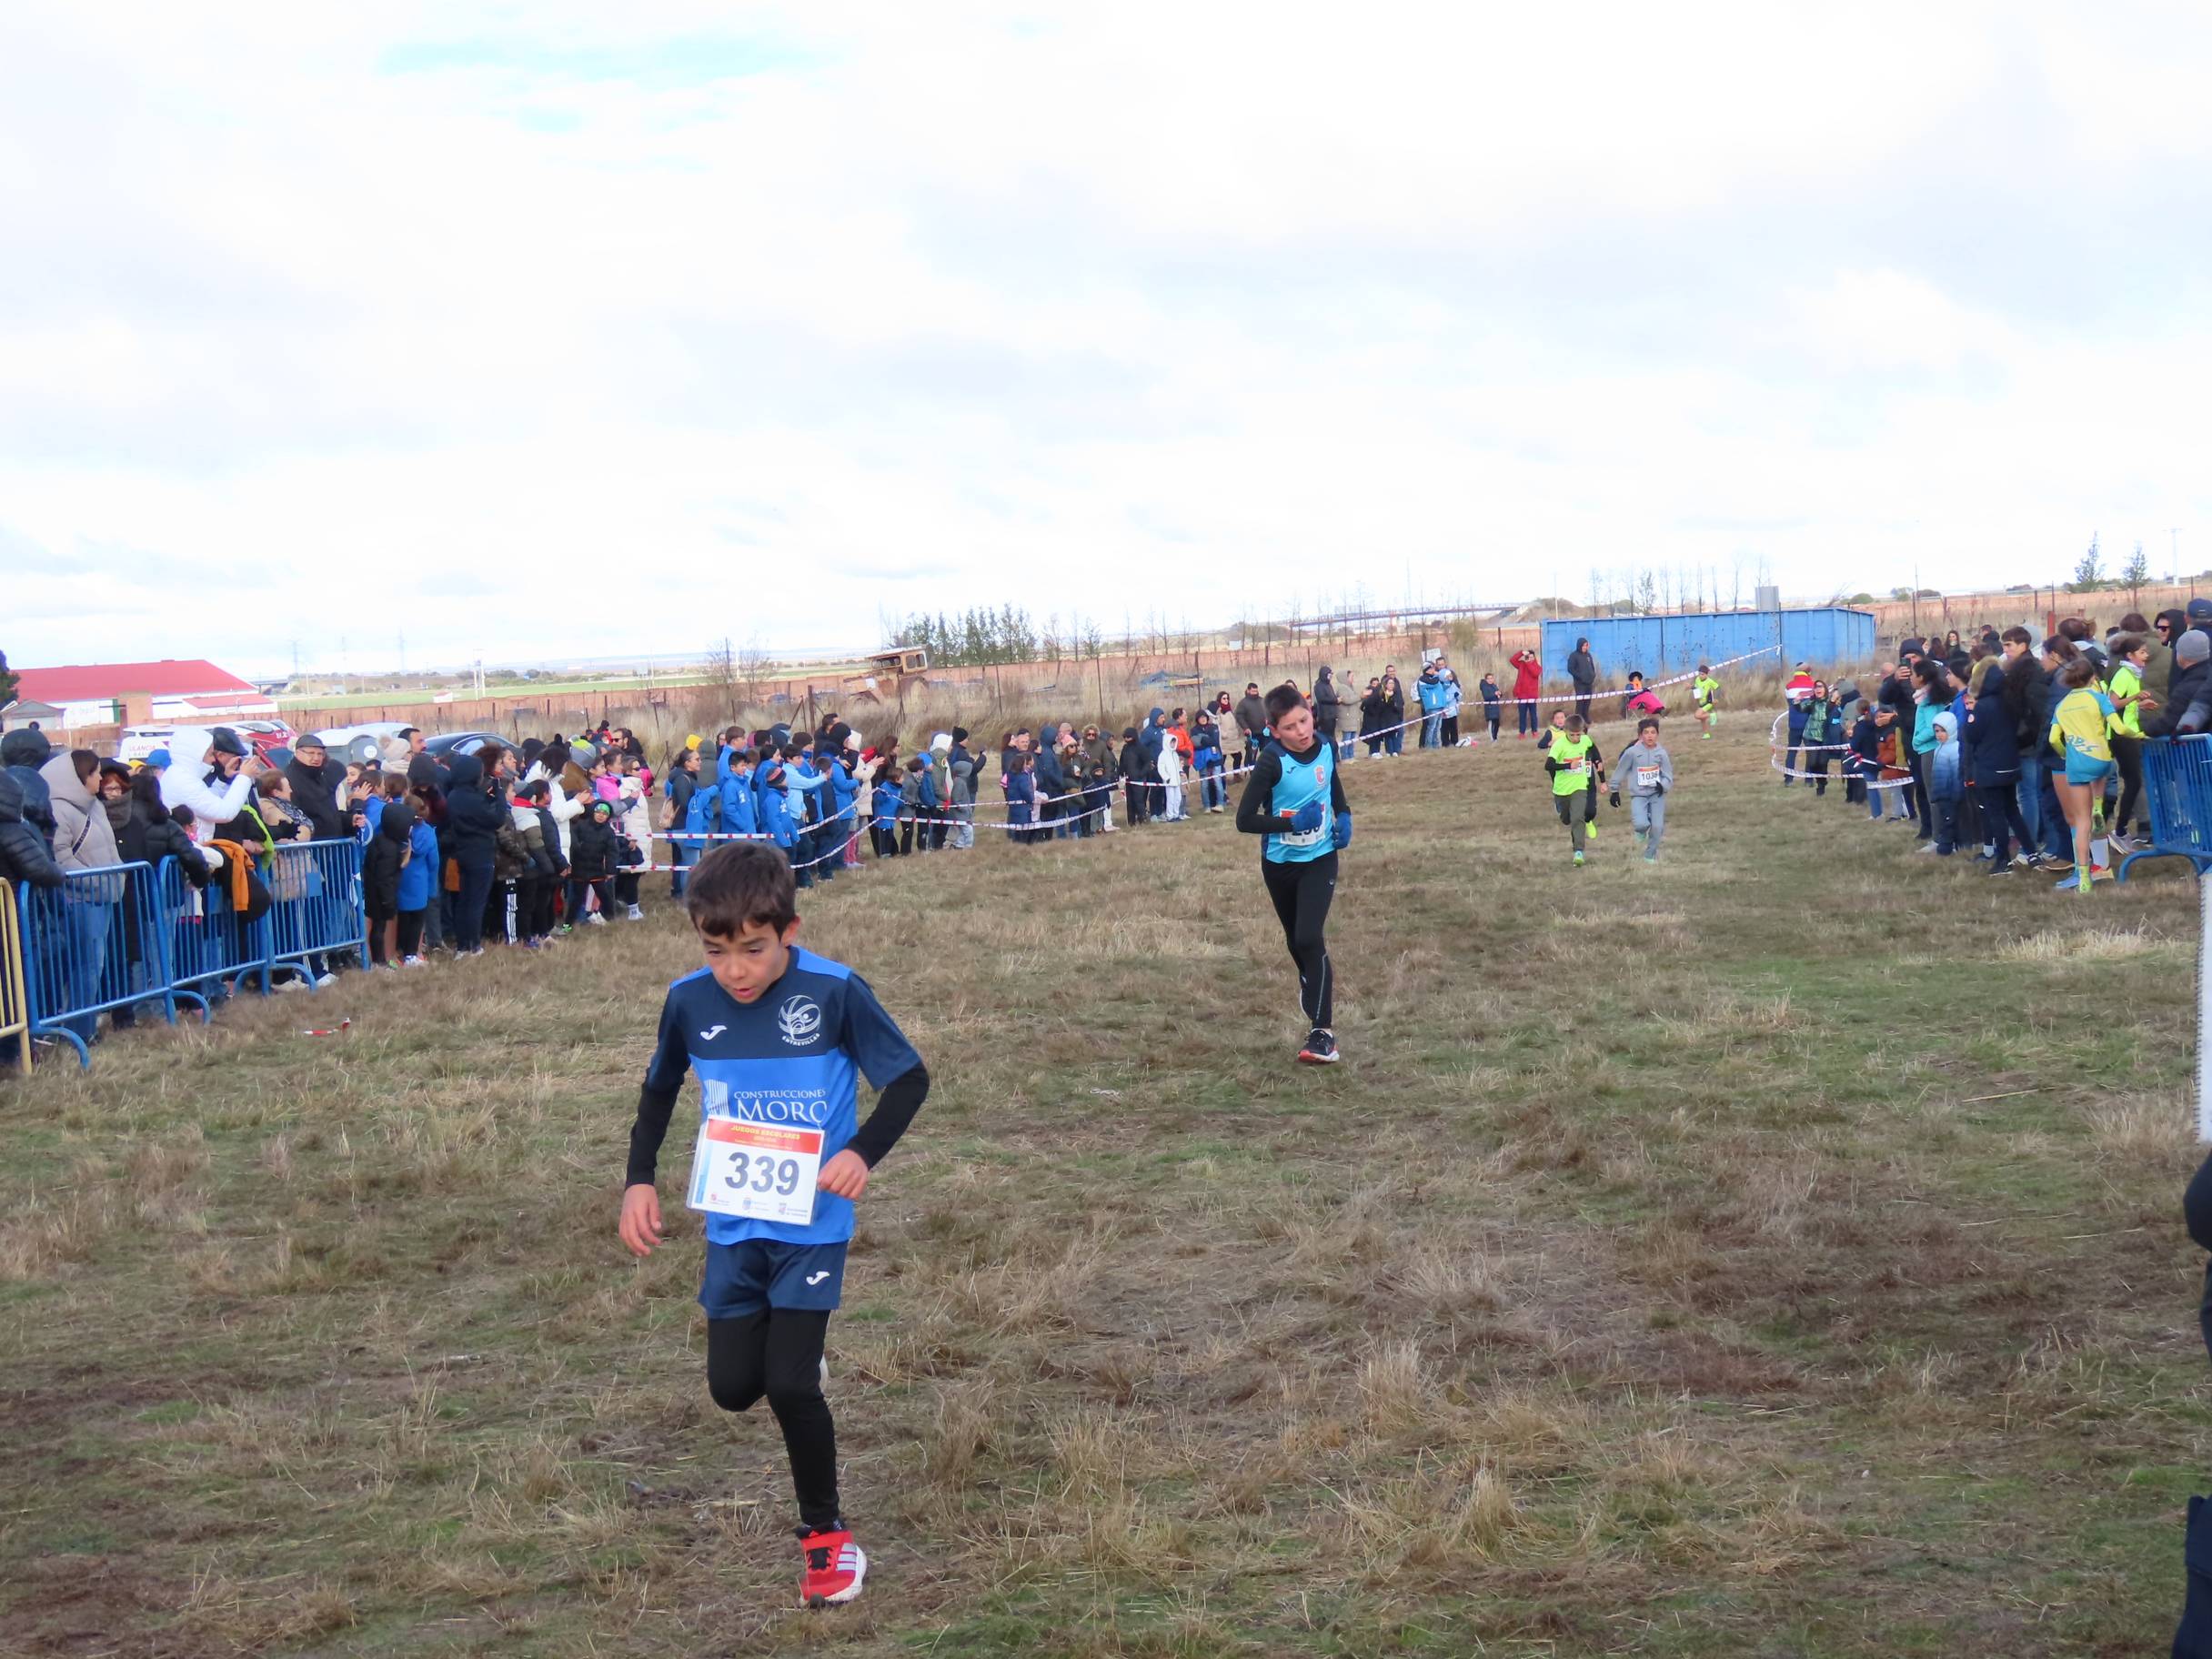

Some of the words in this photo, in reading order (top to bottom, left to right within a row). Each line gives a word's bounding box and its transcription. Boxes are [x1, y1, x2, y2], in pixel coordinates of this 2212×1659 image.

[730, 1124, 759, 1135] JUEGOS
[760, 1130, 801, 1141] ESCOLARES
[724, 1151, 800, 1196] 339
